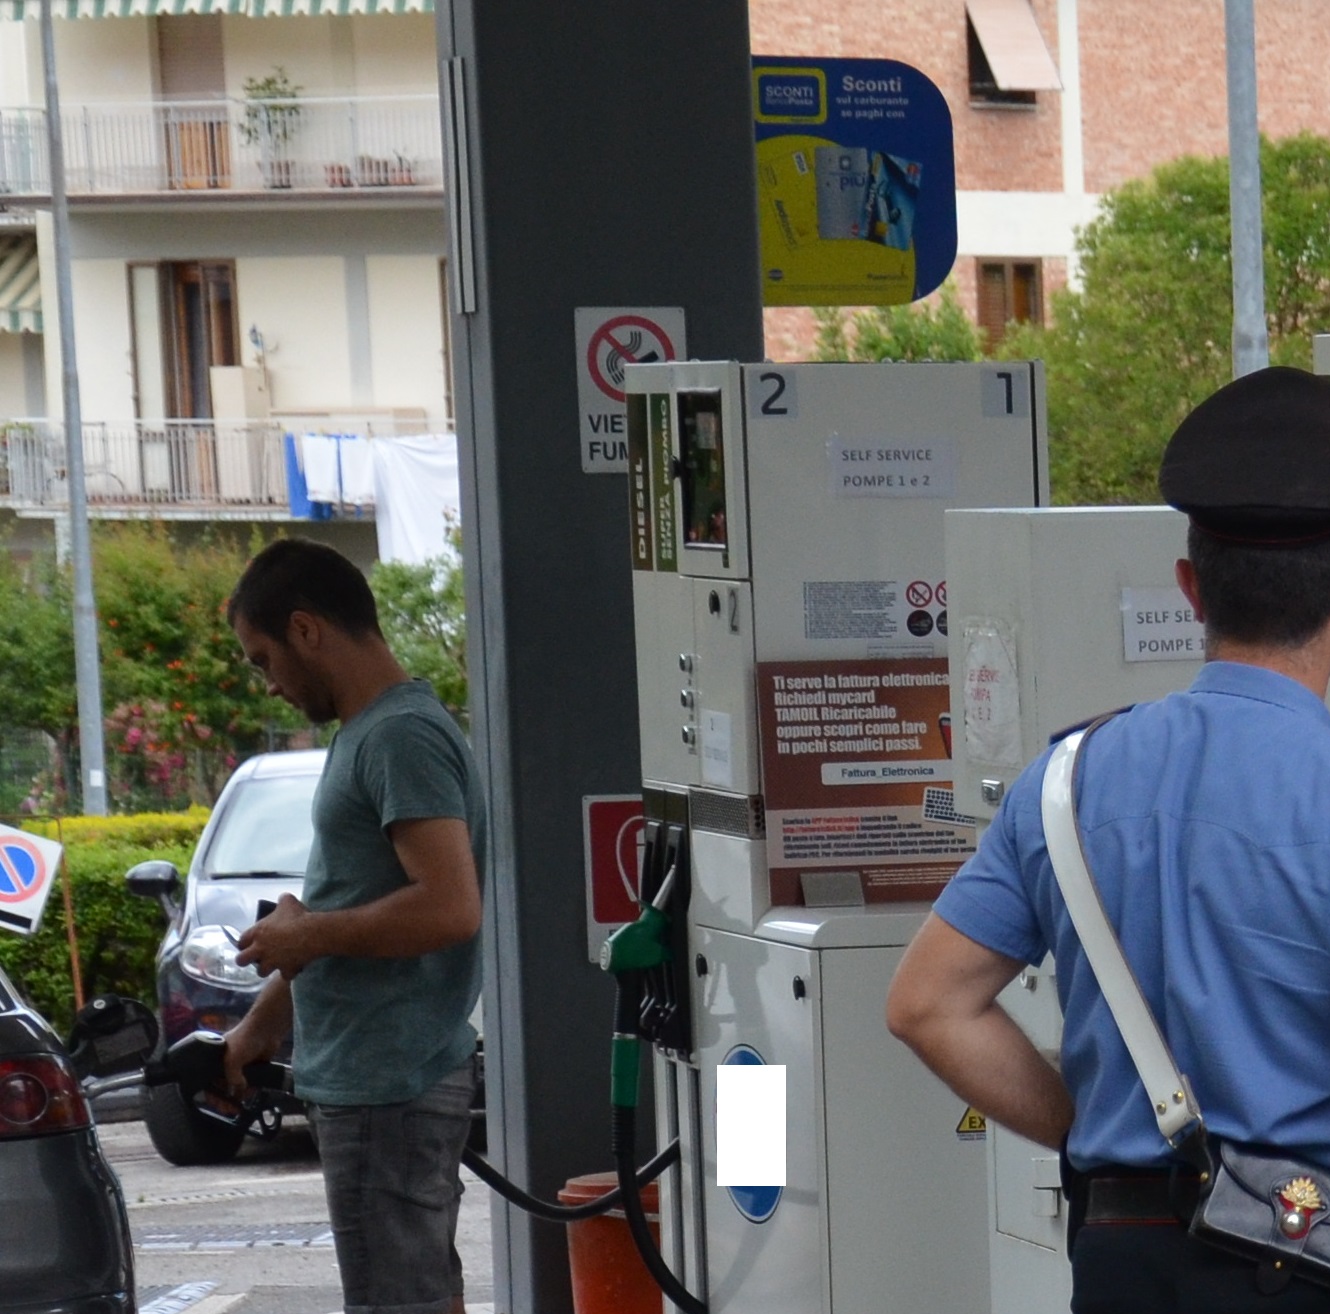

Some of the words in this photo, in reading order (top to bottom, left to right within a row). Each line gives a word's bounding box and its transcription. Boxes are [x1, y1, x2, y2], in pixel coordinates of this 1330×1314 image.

[765, 86, 813, 97] SCONTI
[842, 76, 902, 92] Sconti
[836, 96, 851, 104] sul
[855, 96, 909, 105] carburante
[855, 109, 883, 119] paghi
[886, 110, 905, 118] con
[759, 372, 788, 415] 2
[996, 372, 1014, 414] 1
[588, 414, 628, 433] VIE
[842, 451, 872, 461] SELF
[877, 450, 932, 461] SERVICE
[843, 475, 893, 487] POMPE
[898, 475, 906, 487] 1
[910, 477, 918, 486] e
[922, 475, 930, 486] 2
[635, 458, 646, 559] DIESEL
[1136, 611, 1169, 624] SELF
[1138, 639, 1194, 652] POMPE
[772, 676, 785, 690] Ti
[787, 677, 822, 690] serve
[824, 675, 836, 688] la
[837, 674, 880, 688] fattura
[882, 672, 949, 687] elettronica
[774, 690, 827, 706] Richiedi
[827, 690, 875, 706] mycard
[775, 706, 820, 722] TAMOIL
[821, 705, 896, 721] Ricaricabile
[776, 724, 822, 739] oppure
[824, 722, 864, 737] scopri
[865, 722, 900, 735] come
[902, 720, 927, 734] fare
[777, 740, 790, 754] in
[792, 739, 828, 755] pochi
[829, 737, 884, 754] semplici
[969, 1116, 986, 1129] EX
